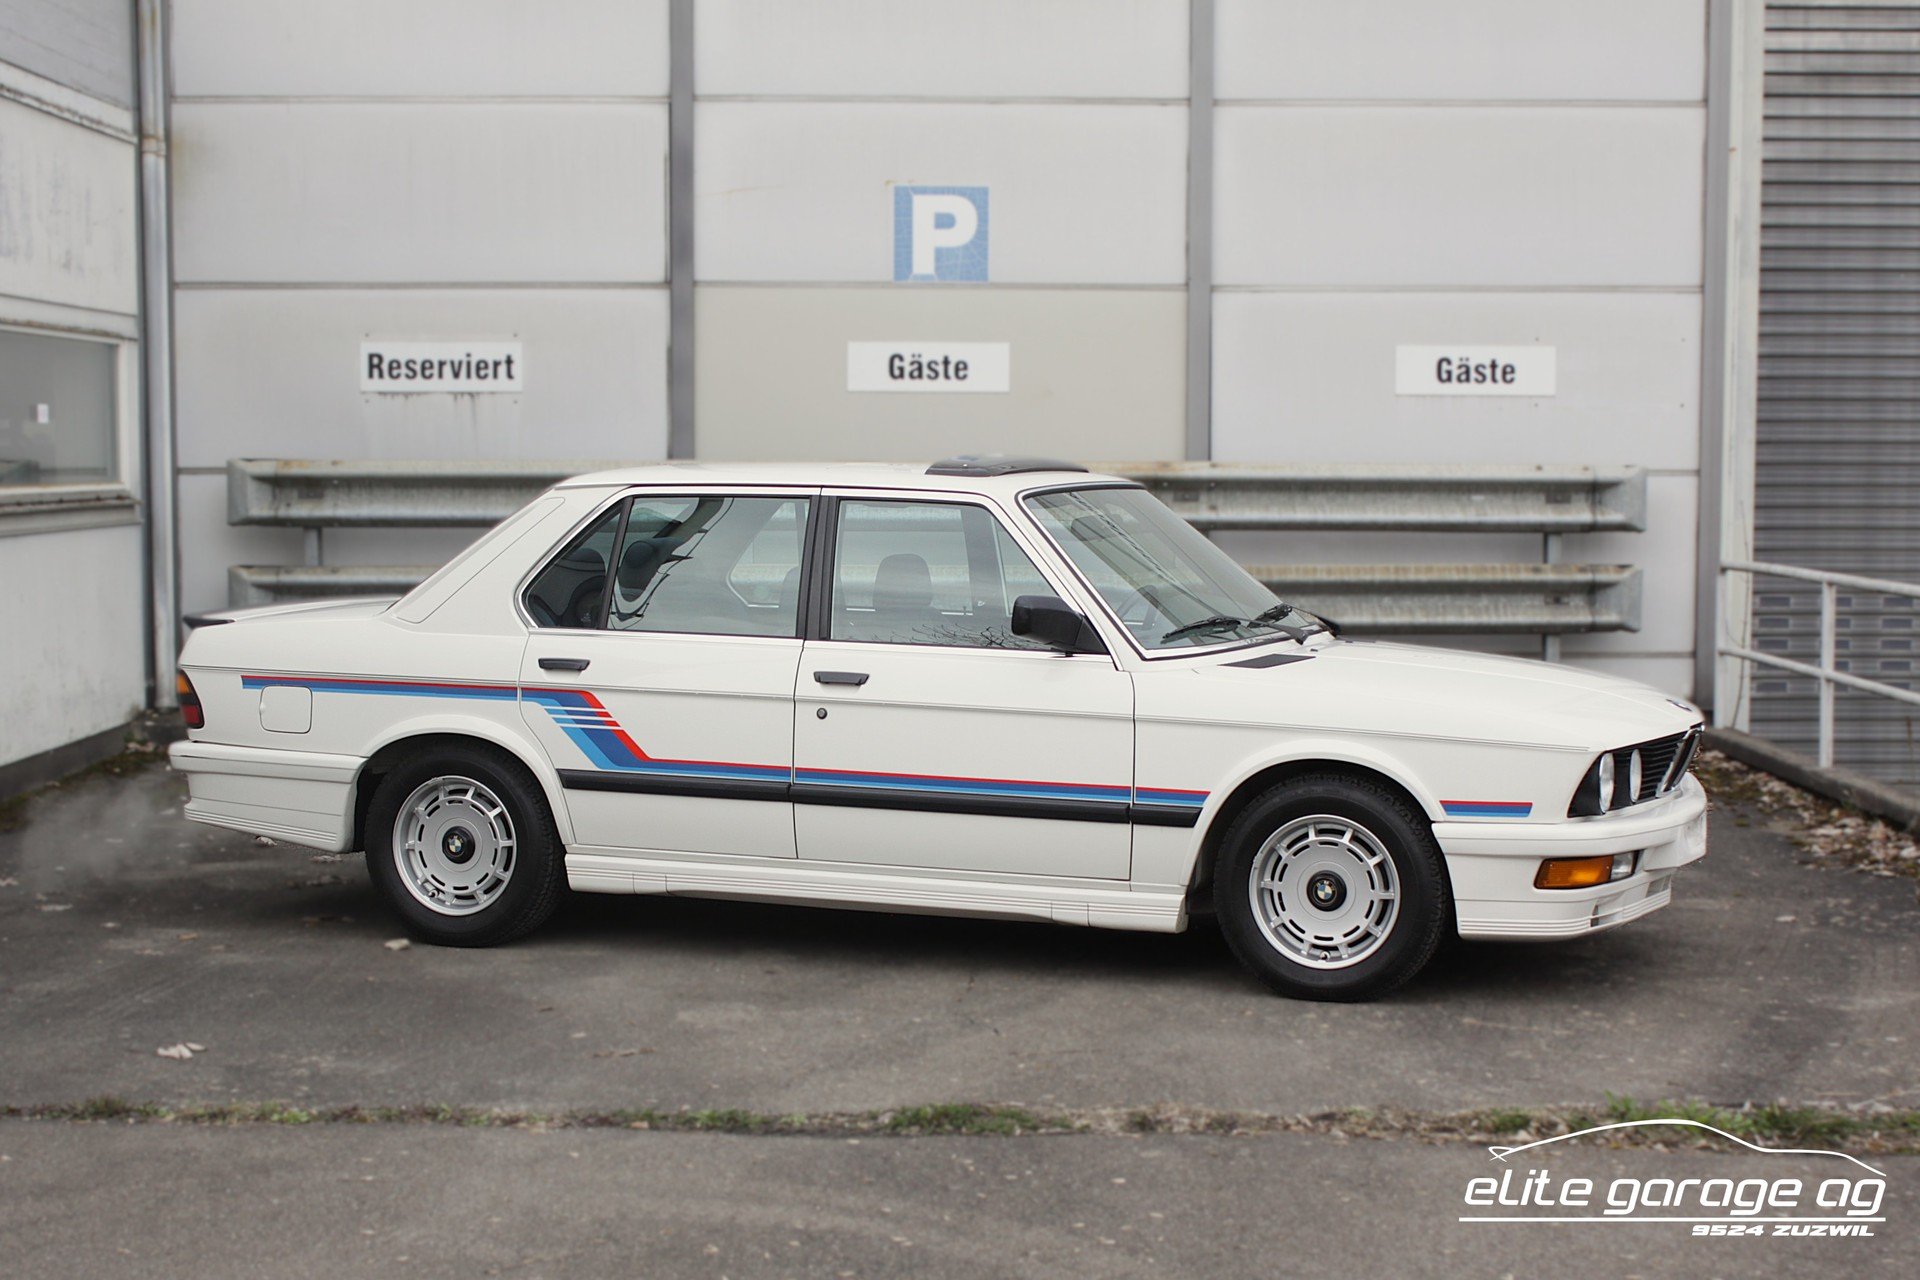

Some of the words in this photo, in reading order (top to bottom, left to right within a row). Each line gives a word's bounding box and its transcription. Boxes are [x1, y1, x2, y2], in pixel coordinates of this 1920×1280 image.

[912, 194, 978, 275] P
[367, 352, 515, 381] Reserviert
[888, 353, 969, 381] Gäste
[1436, 356, 1516, 384] Gäste
